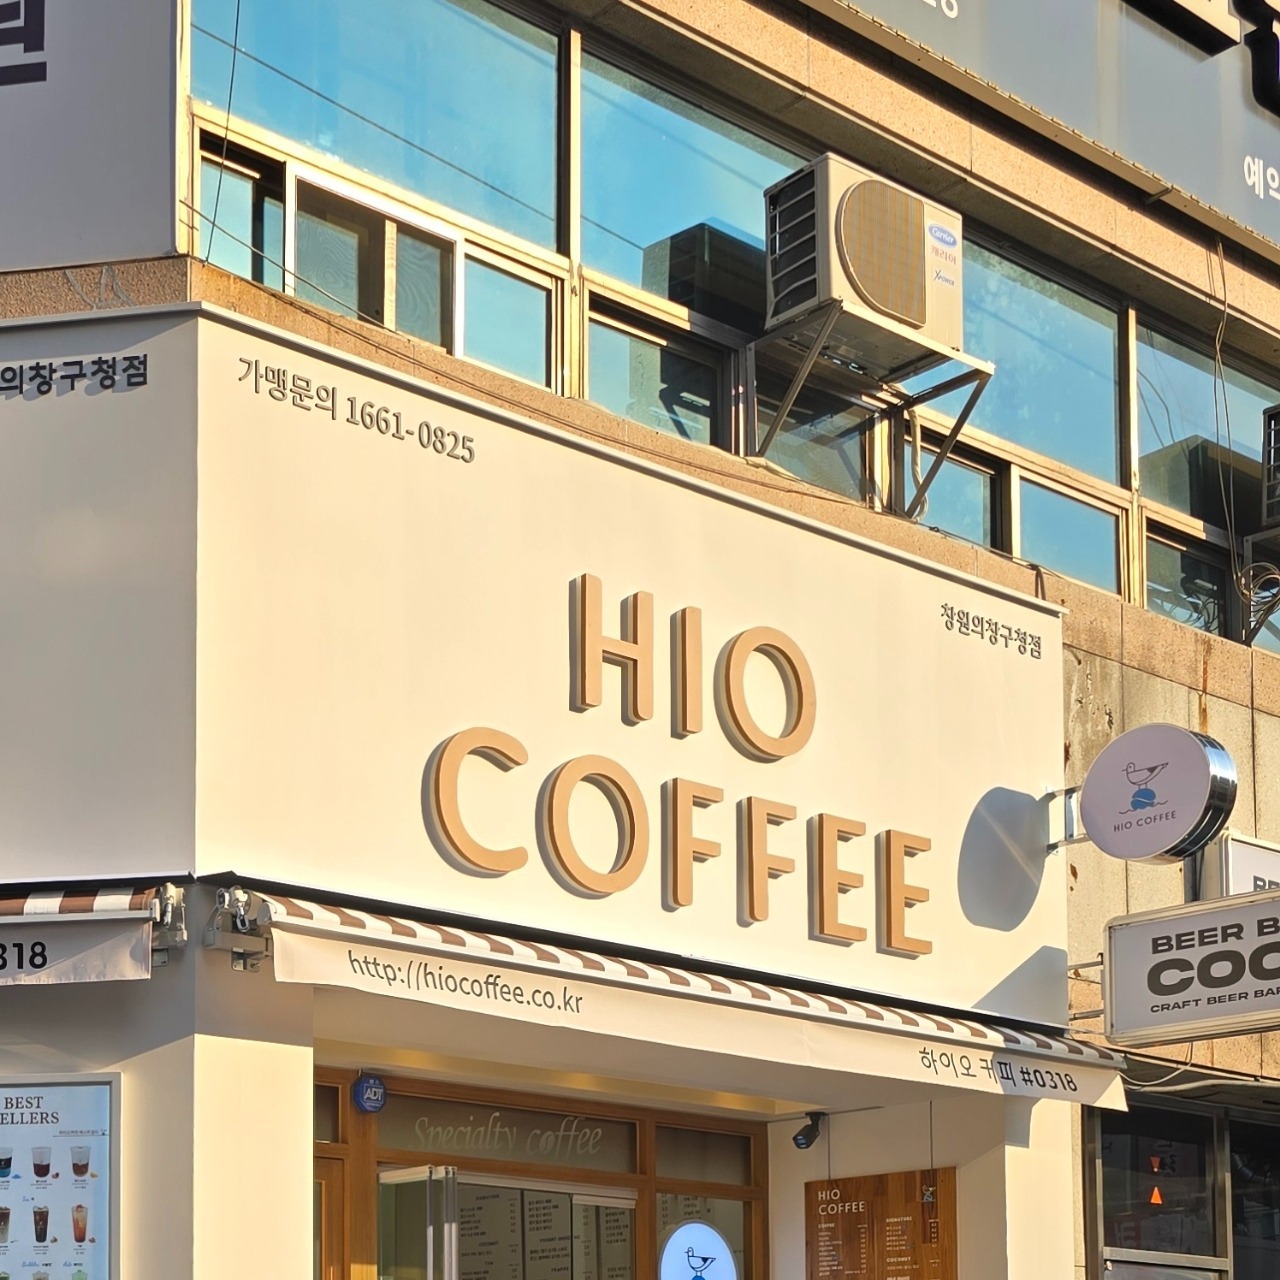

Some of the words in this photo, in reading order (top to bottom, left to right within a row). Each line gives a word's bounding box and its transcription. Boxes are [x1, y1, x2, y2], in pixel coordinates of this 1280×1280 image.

[932, 227, 954, 244] Carrier
[238, 357, 338, 420] 가맹문의
[346, 396, 475, 463] 1661-0825
[940, 603, 1042, 660] 창원의창구청점
[569, 573, 816, 760] HIO
[1113, 820, 1133, 833] HIO
[1136, 810, 1177, 827] COFFEE
[422, 726, 933, 956] COFFEE
[1151, 923, 1245, 955] BEER
[348, 949, 583, 1014] http://hiocoffee.co.kr
[1150, 998, 1202, 1014] CRAFT
[1207, 990, 1249, 1006] BEER
[919, 1047, 977, 1079] 하이오
[979, 1058, 1017, 1087] 커피
[1020, 1066, 1078, 1092] #0318
[4, 1096, 43, 1110] BEST
[364, 1087, 384, 1100] ADT
[415, 1111, 518, 1151] Specialty
[526, 1116, 602, 1160] coffee
[818, 1189, 841, 1201] HIO
[818, 1201, 866, 1215] COFFEE
